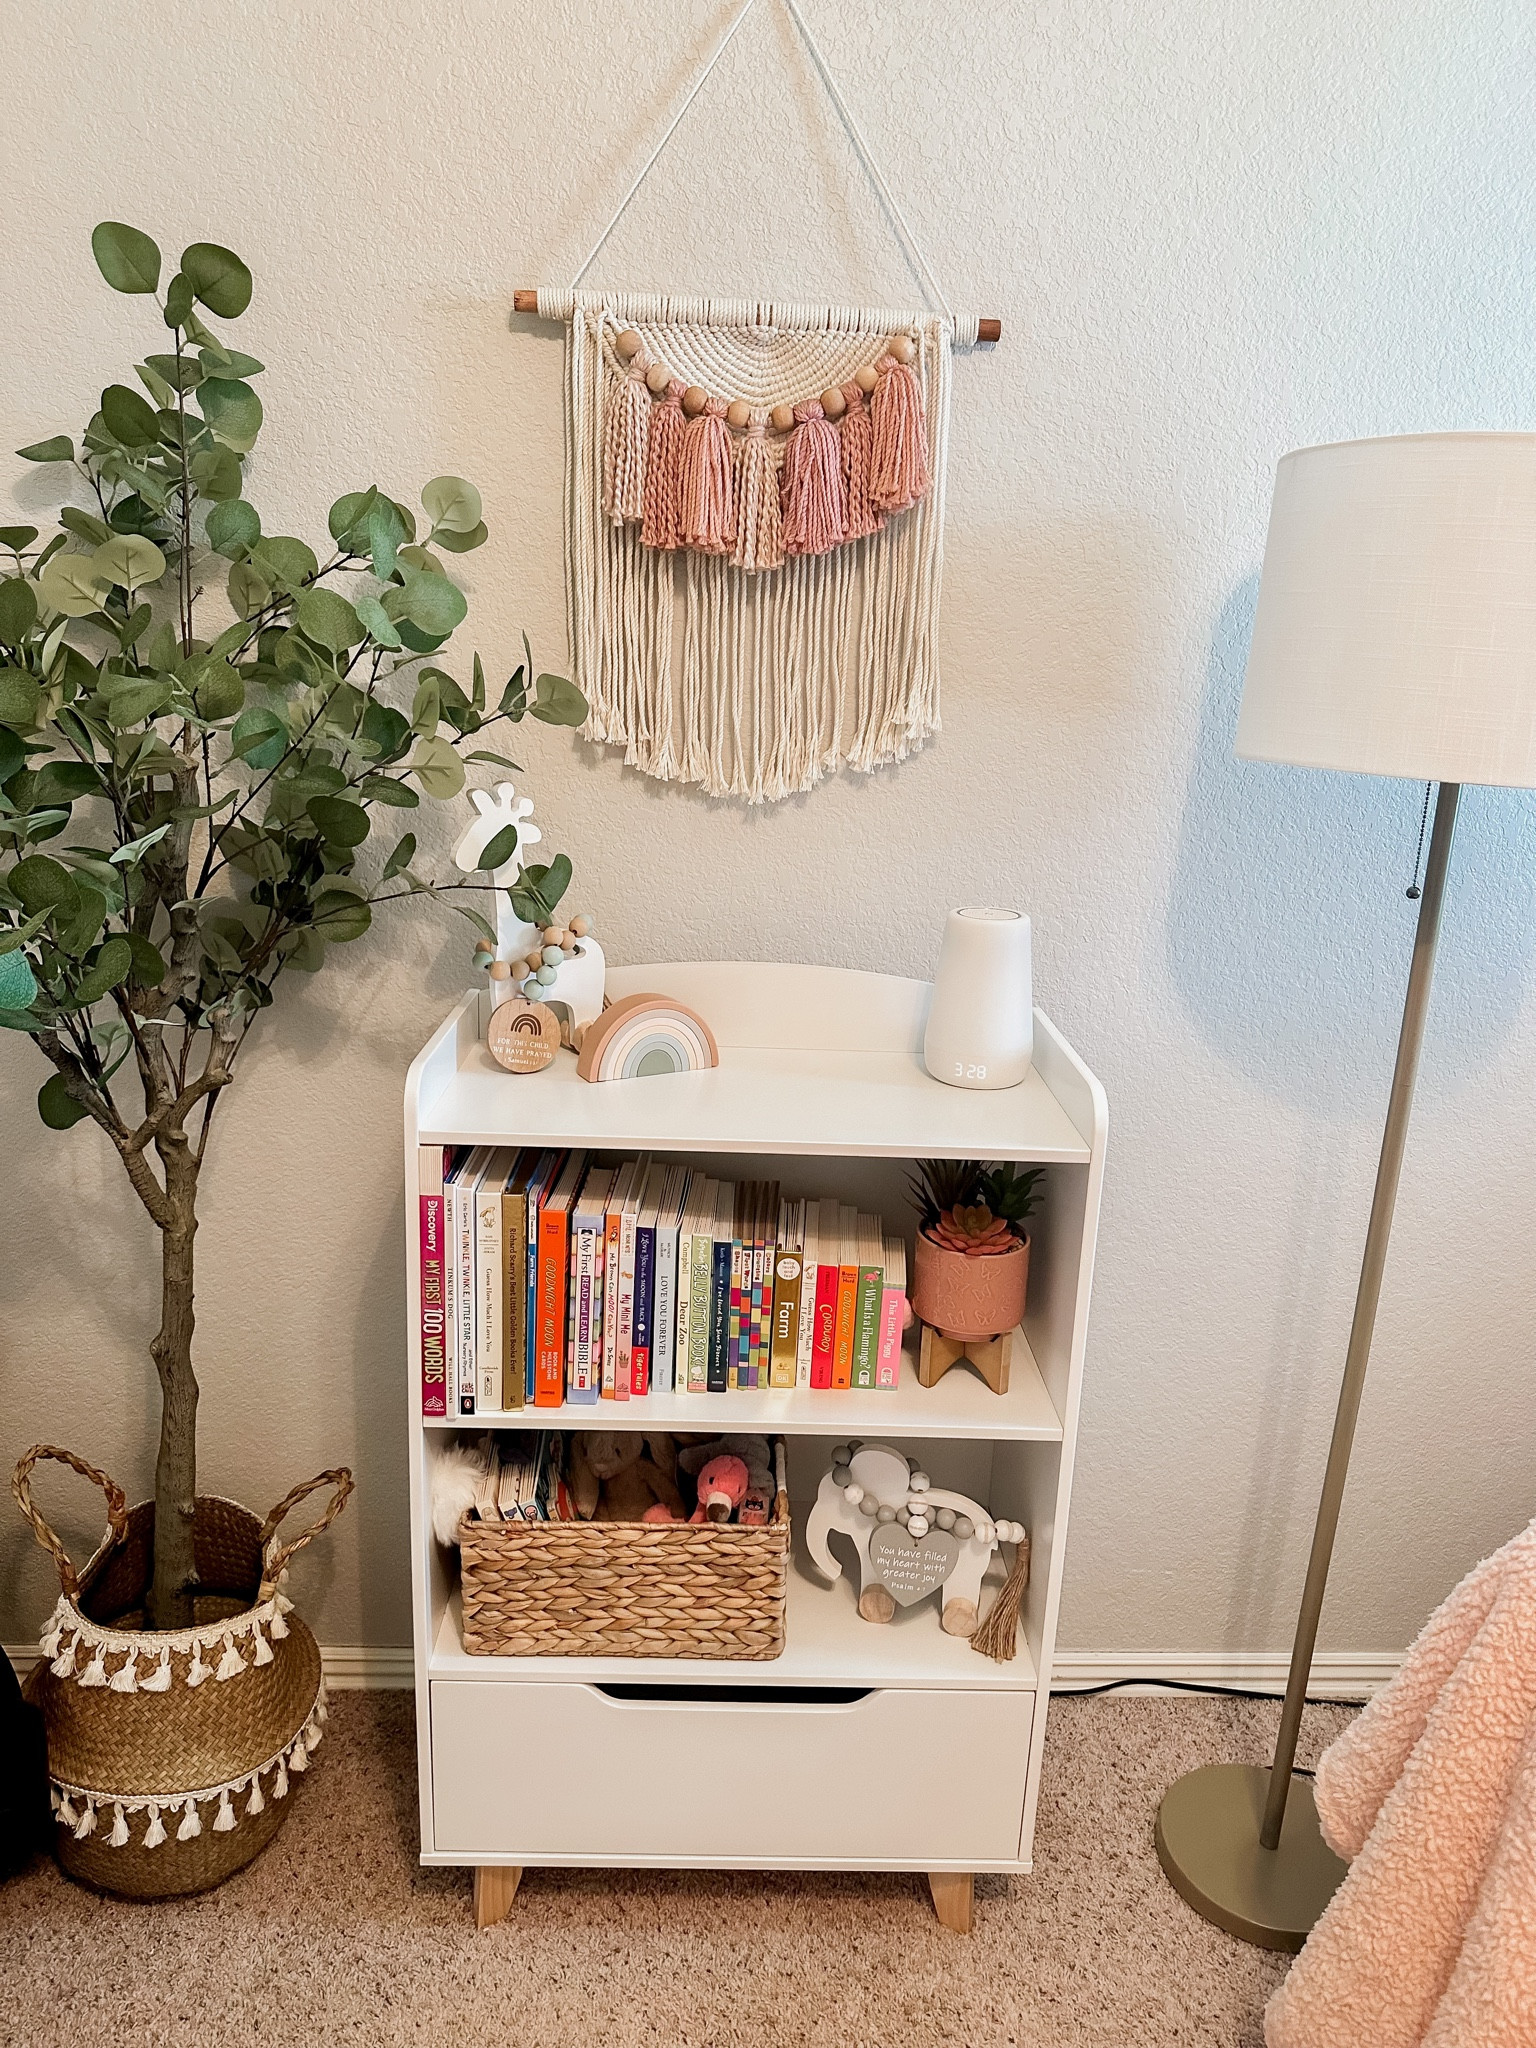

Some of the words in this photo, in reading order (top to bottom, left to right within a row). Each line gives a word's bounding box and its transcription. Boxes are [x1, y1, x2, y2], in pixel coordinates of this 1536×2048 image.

[497, 1037, 510, 1045] FOR
[530, 1041, 549, 1049] CHILD
[506, 1047, 524, 1056] HAVE
[527, 1050, 552, 1059] PRAYED
[508, 1057, 528, 1065] Samuel
[426, 1200, 438, 1252] Discovery
[462, 1229, 471, 1263] TWINKLE,
[509, 1227, 517, 1254] Richard
[580, 1236, 592, 1251] My
[425, 1259, 441, 1275] MY
[508, 1255, 517, 1281] Scarry's
[581, 1253, 592, 1275] First
[681, 1241, 691, 1275] Campbell
[755, 1251, 763, 1281] Counting
[463, 1264, 471, 1298] TWINKLE,
[609, 1262, 617, 1281] Brown
[693, 1262, 709, 1293] BELLY
[424, 1277, 441, 1306] FIRST
[545, 1257, 557, 1316] GOODNIGHT
[581, 1276, 590, 1299] READ
[660, 1275, 668, 1298] LOVE
[463, 1299, 471, 1320] LITTLE
[580, 1300, 589, 1313] and
[620, 1293, 632, 1305] My
[659, 1299, 668, 1317] YOU
[807, 1297, 815, 1316] Guess
[864, 1289, 877, 1312] What
[888, 1299, 899, 1316] This
[423, 1307, 444, 1335] 100
[620, 1306, 632, 1322] Mini
[679, 1300, 689, 1326] Dear
[690, 1294, 709, 1335] BUTTON
[715, 1316, 723, 1328] You
[779, 1301, 794, 1339] Farm
[841, 1290, 852, 1338] GOODNIGHT
[863, 1312, 875, 1320] Is
[463, 1322, 472, 1341] STAR
[544, 1318, 556, 1348] MOON
[580, 1315, 589, 1342] LEARN
[620, 1324, 631, 1335] Me
[679, 1327, 688, 1346] Zoo
[816, 1303, 833, 1353] CORDUROY
[886, 1316, 897, 1337] Little
[658, 1319, 668, 1356] FOREVER
[805, 1333, 813, 1352] Much
[857, 1327, 874, 1369] Flamingo?
[577, 1343, 590, 1375] BIBLE
[839, 1341, 848, 1365] MOON
[883, 1338, 895, 1359] Piggy
[424, 1335, 445, 1384] WORDS
[635, 1352, 646, 1370] tiger
[635, 1373, 644, 1391] tales
[879, 1545, 895, 1556] You
[897, 1547, 921, 1559] have
[924, 1550, 948, 1562] filled
[876, 1556, 891, 1567] my
[892, 1558, 920, 1569] heart
[923, 1563, 946, 1573] with
[882, 1568, 920, 1579] greater
[921, 1571, 936, 1584] joy
[891, 1581, 914, 1590] Psalm
